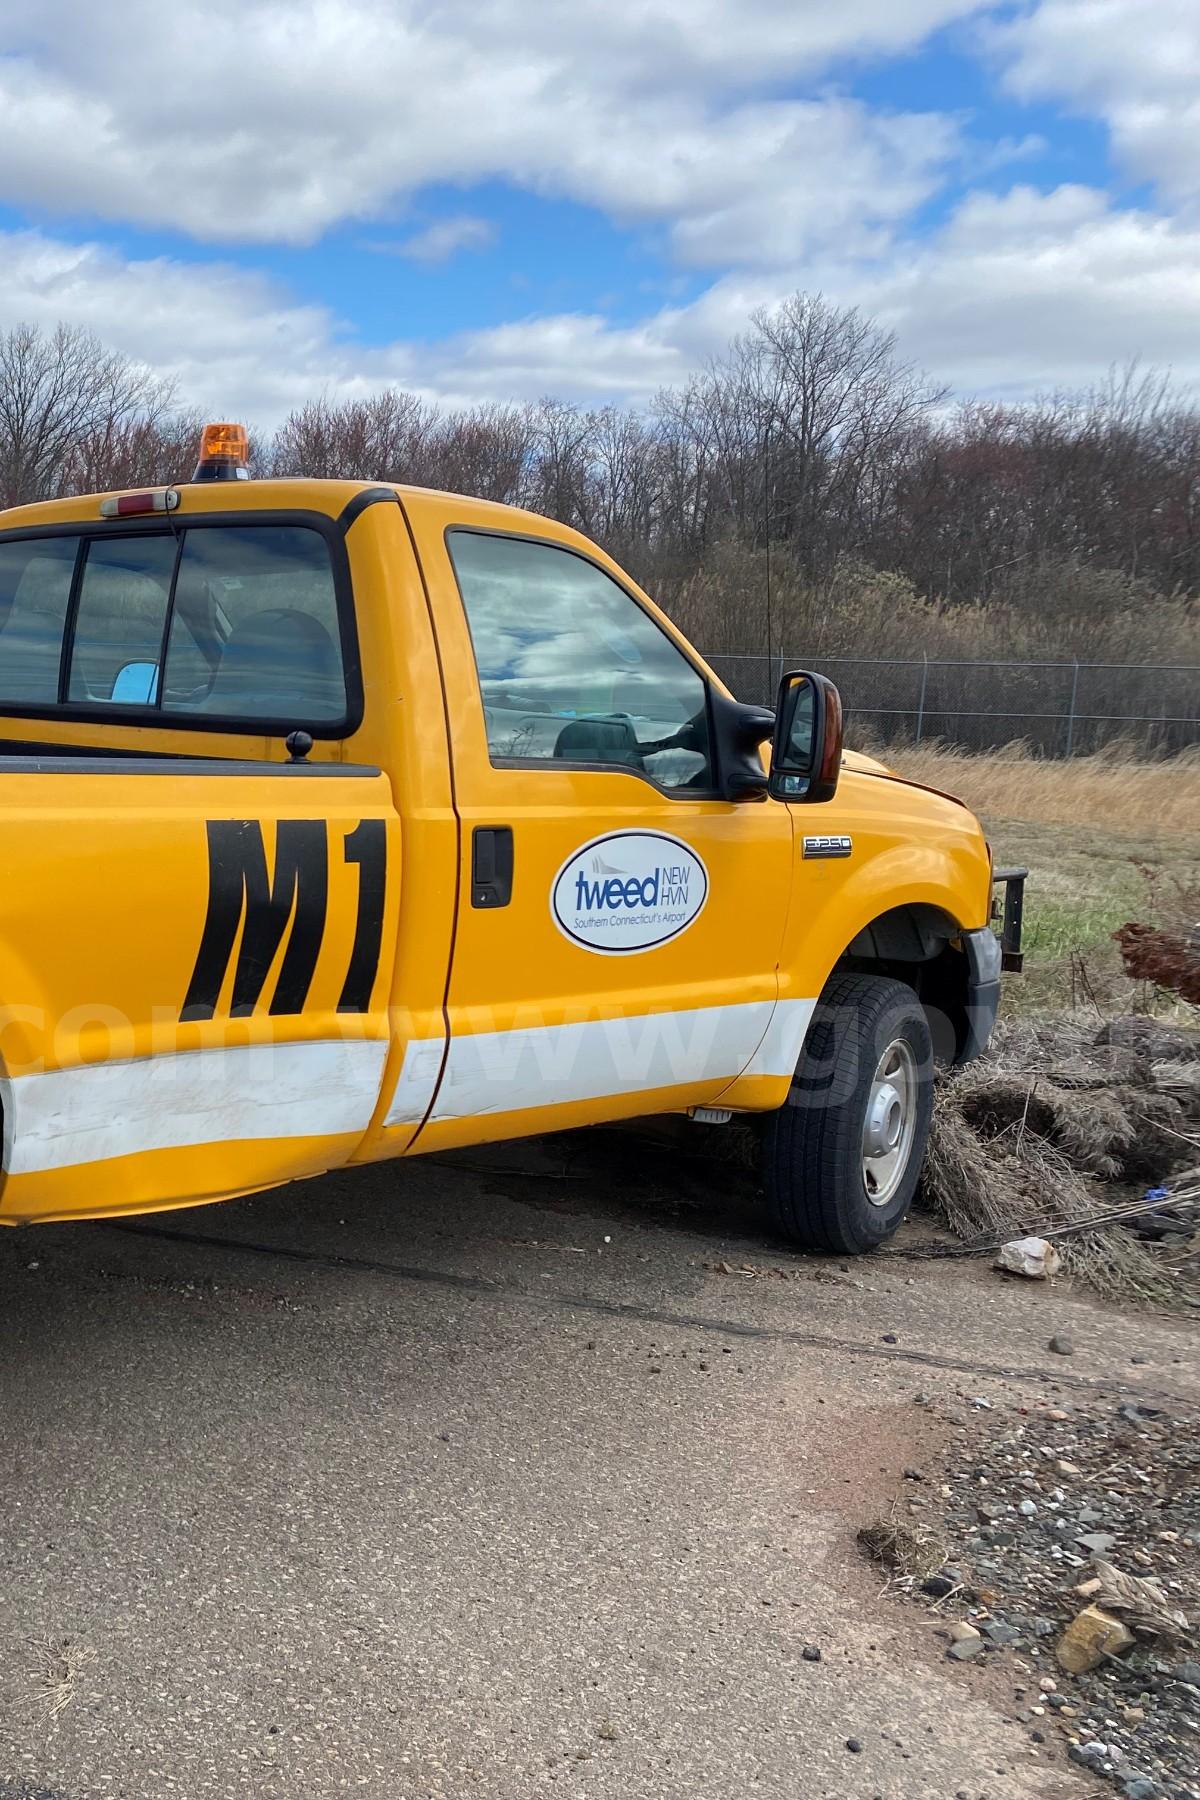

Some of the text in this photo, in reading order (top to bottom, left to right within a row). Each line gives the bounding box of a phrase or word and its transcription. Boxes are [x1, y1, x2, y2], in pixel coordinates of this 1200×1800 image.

[662, 867, 690, 885] NEW
[576, 868, 660, 910] tweed
[660, 886, 688, 906] HVN
[179, 819, 386, 1022] M1
[574, 912, 686, 928] Southern Connecticut's Airport
